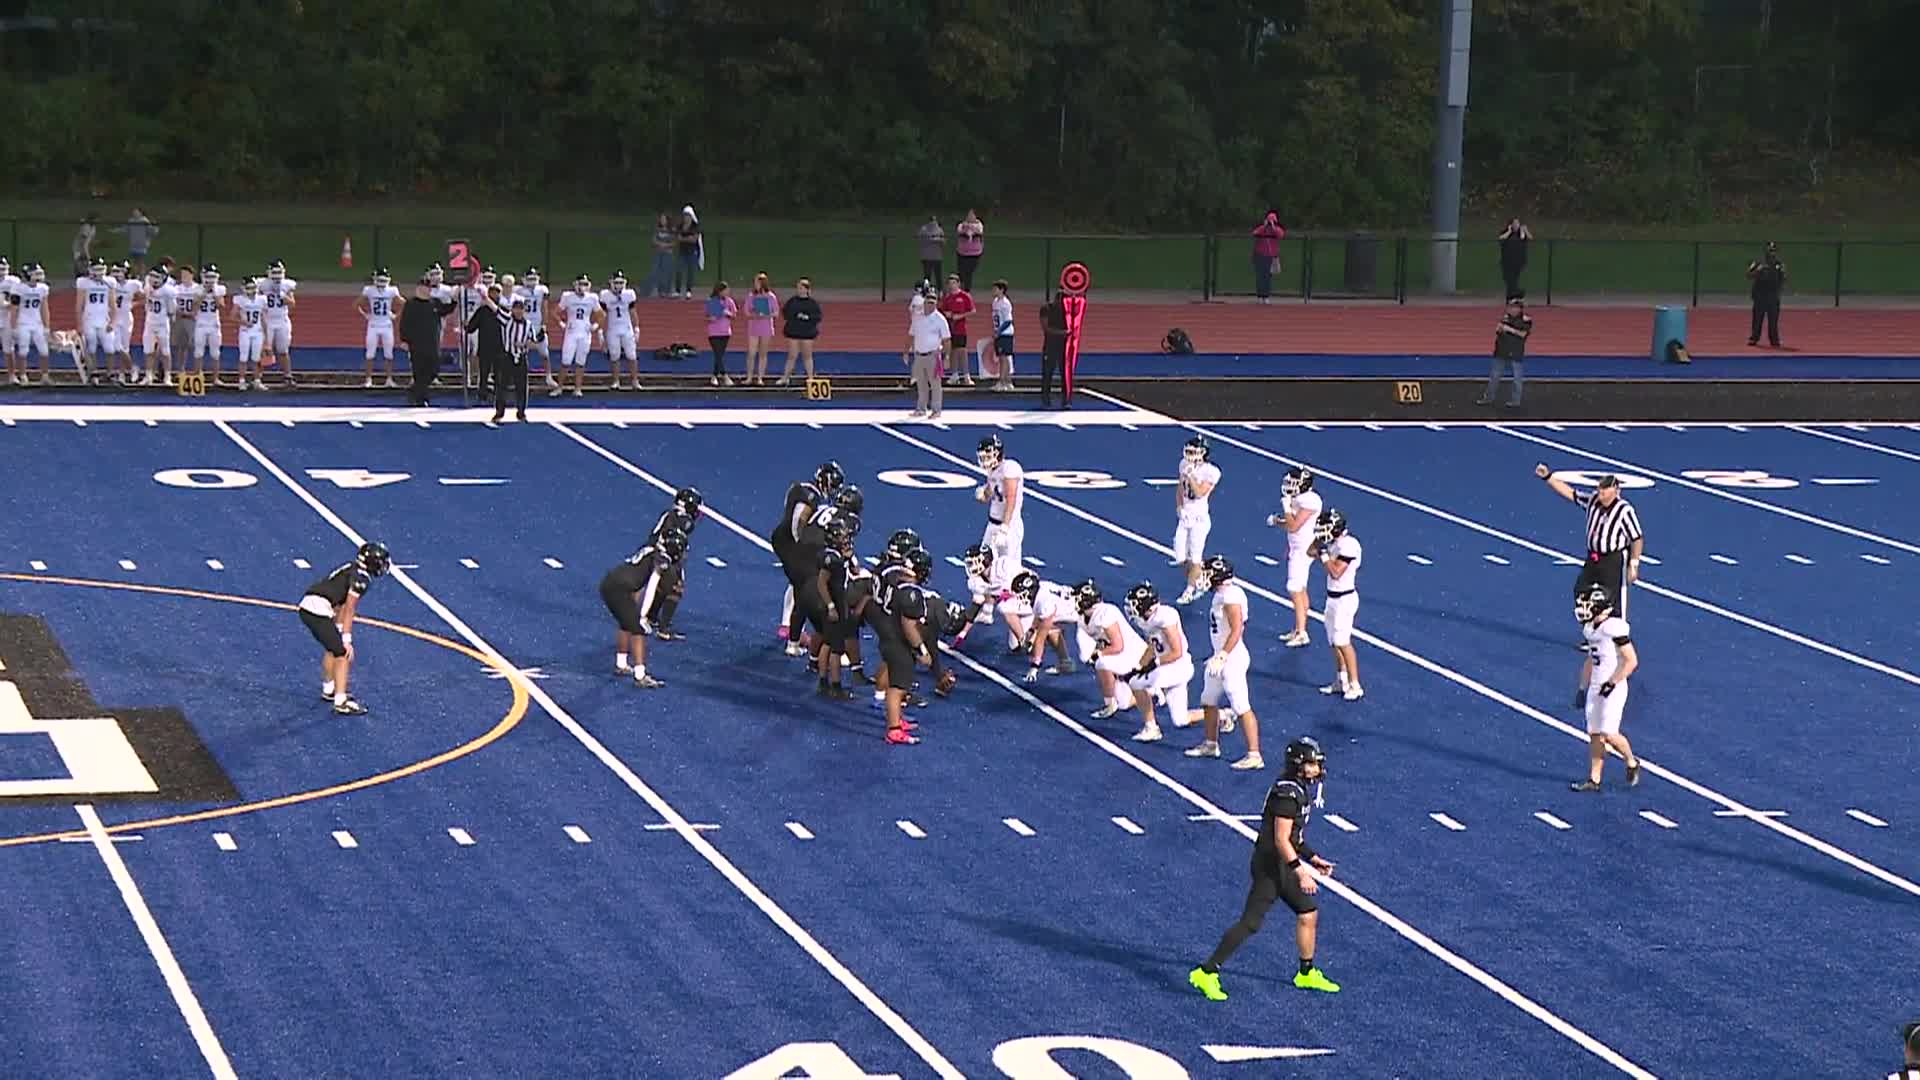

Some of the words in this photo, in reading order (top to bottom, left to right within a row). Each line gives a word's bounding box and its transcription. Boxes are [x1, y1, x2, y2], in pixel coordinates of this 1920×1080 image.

[448, 243, 469, 268] 2
[182, 377, 202, 394] 40
[811, 381, 829, 398] 30
[1402, 385, 1420, 400] 20
